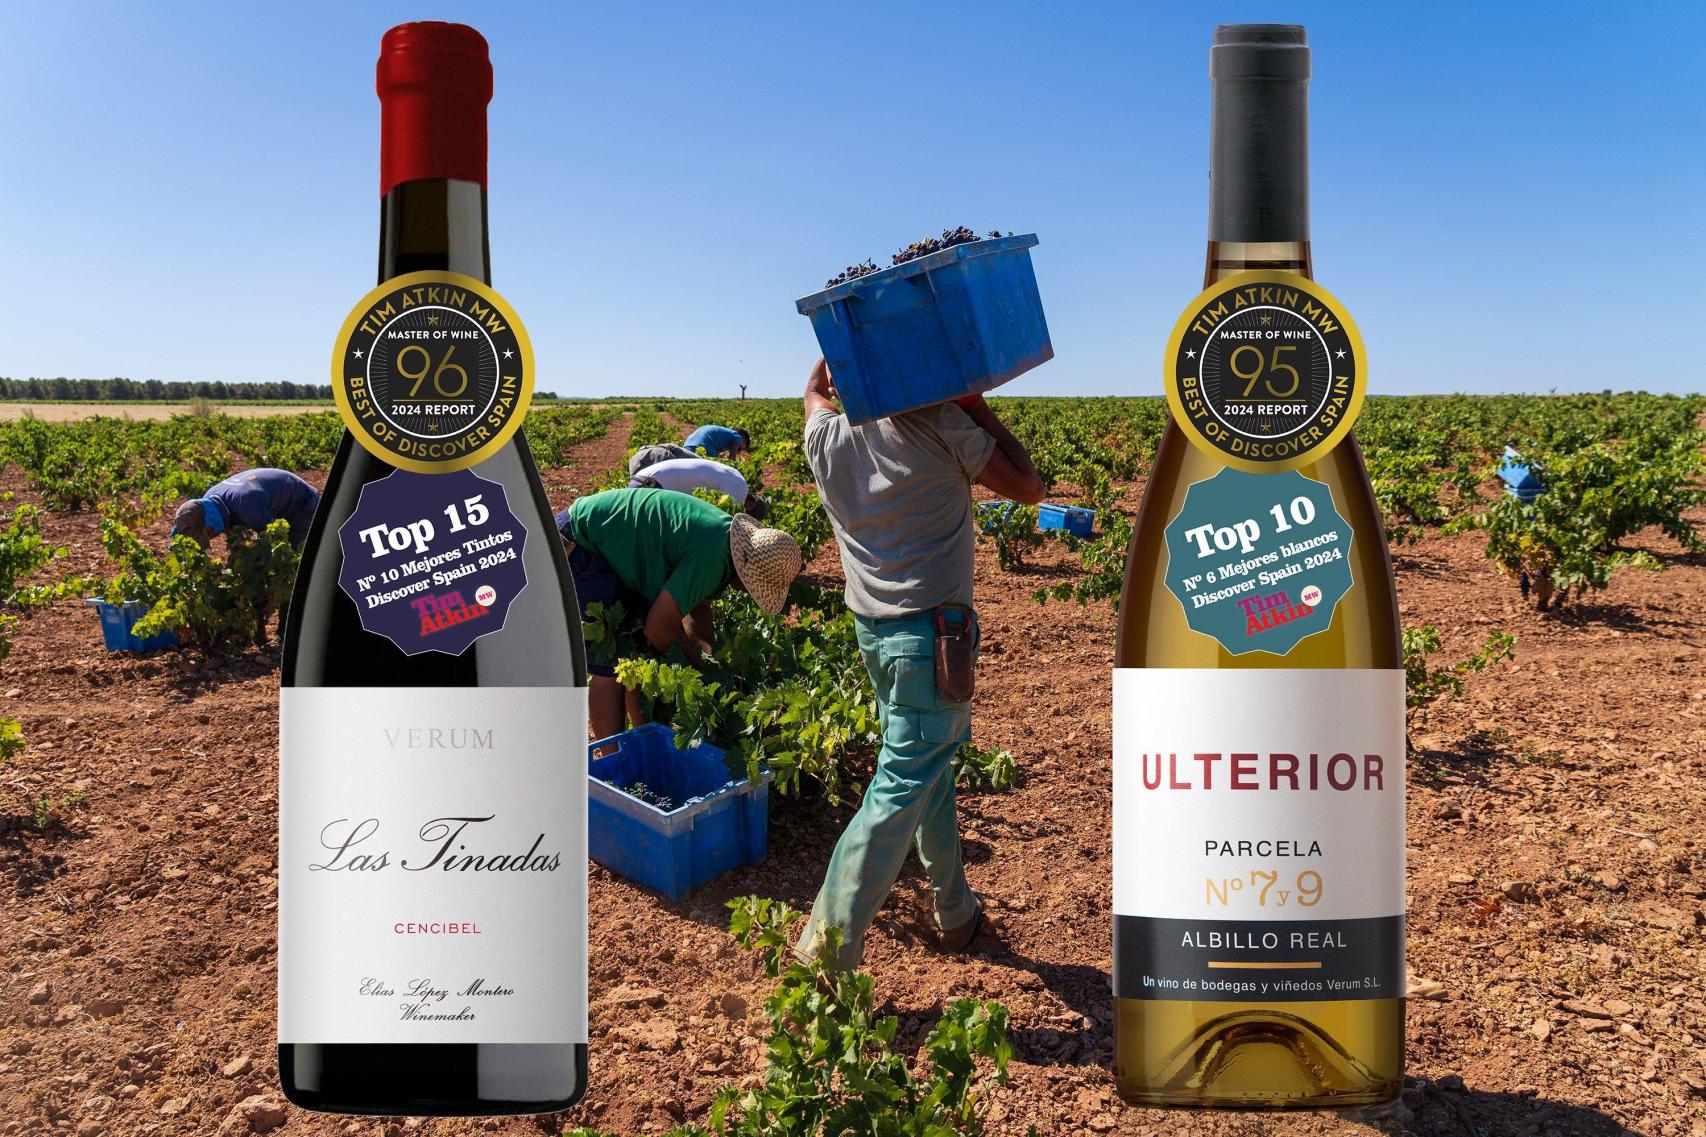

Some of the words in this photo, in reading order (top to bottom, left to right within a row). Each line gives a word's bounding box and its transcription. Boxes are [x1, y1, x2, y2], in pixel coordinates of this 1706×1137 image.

[360, 300, 396, 336] TIM
[402, 287, 466, 309] ATKIN
[469, 300, 506, 334] MW
[1192, 301, 1229, 335] TIM
[1235, 287, 1298, 309] ATKIN
[1302, 301, 1339, 334] MW
[388, 331, 429, 339] MASTER
[435, 331, 447, 339] OF
[451, 331, 478, 339] WINE
[1221, 331, 1262, 339] MASTER
[1266, 331, 1279, 339] OF
[1283, 331, 1311, 339] WINE
[397, 345, 468, 397] 96
[1231, 345, 1299, 397] 95
[350, 377, 376, 419] BEST
[373, 422, 397, 442] OF
[399, 426, 491, 457] DISCOVER
[487, 376, 516, 427] SPAIN
[392, 405, 421, 415] 2024
[426, 405, 475, 415] REPORT
[1183, 377, 1209, 419] BEST
[1205, 422, 1229, 443] OF
[1231, 426, 1323, 457] DISCOVER
[1321, 376, 1349, 427] SPAIN
[1224, 405, 1253, 415] 2024
[1258, 405, 1308, 414] REPORT
[359, 519, 435, 558] Top
[444, 494, 489, 534] 15
[1185, 519, 1260, 558] Top
[1269, 496, 1315, 534] 10
[381, 569, 398, 584] 10
[402, 549, 462, 577] Mejores
[463, 531, 513, 555] Tintos
[1206, 572, 1216, 584] 6
[1218, 551, 1279, 580] Mejores
[1280, 531, 1338, 558] blancos
[365, 578, 430, 608] Discover
[432, 563, 477, 587] Spain
[479, 548, 517, 570] 2024
[1191, 578, 1255, 608] Discover
[1258, 563, 1302, 587] Spain
[1304, 548, 1342, 570] 2024
[1304, 591, 1319, 601] MW
[411, 591, 462, 617] Tim
[478, 591, 494, 602] MW
[1237, 591, 1290, 616] Tim
[420, 601, 489, 637] Atkin
[1247, 601, 1314, 637] Atkin
[384, 728, 494, 750] VERUM
[1142, 753, 1384, 791] ULTERIOR
[308, 818, 391, 871] Las
[400, 814, 561, 871] Tinadas
[1205, 840, 1323, 857] PARCELA
[394, 923, 481, 934] CENCIBEL
[1182, 931, 1278, 949] ALBILLO
[1290, 932, 1347, 949] REAL
[359, 977, 395, 996] Elias
[403, 979, 448, 1001] López
[457, 979, 514, 997] Montero
[1143, 976, 1155, 987] Un
[1157, 978, 1179, 989] vino
[1183, 979, 1197, 990] de
[1202, 979, 1256, 992] bodegas
[1273, 980, 1323, 991] viñedos
[1327, 979, 1361, 990] Verum
[1364, 976, 1381, 988] S.L.
[399, 1004, 476, 1021] Winemaker
